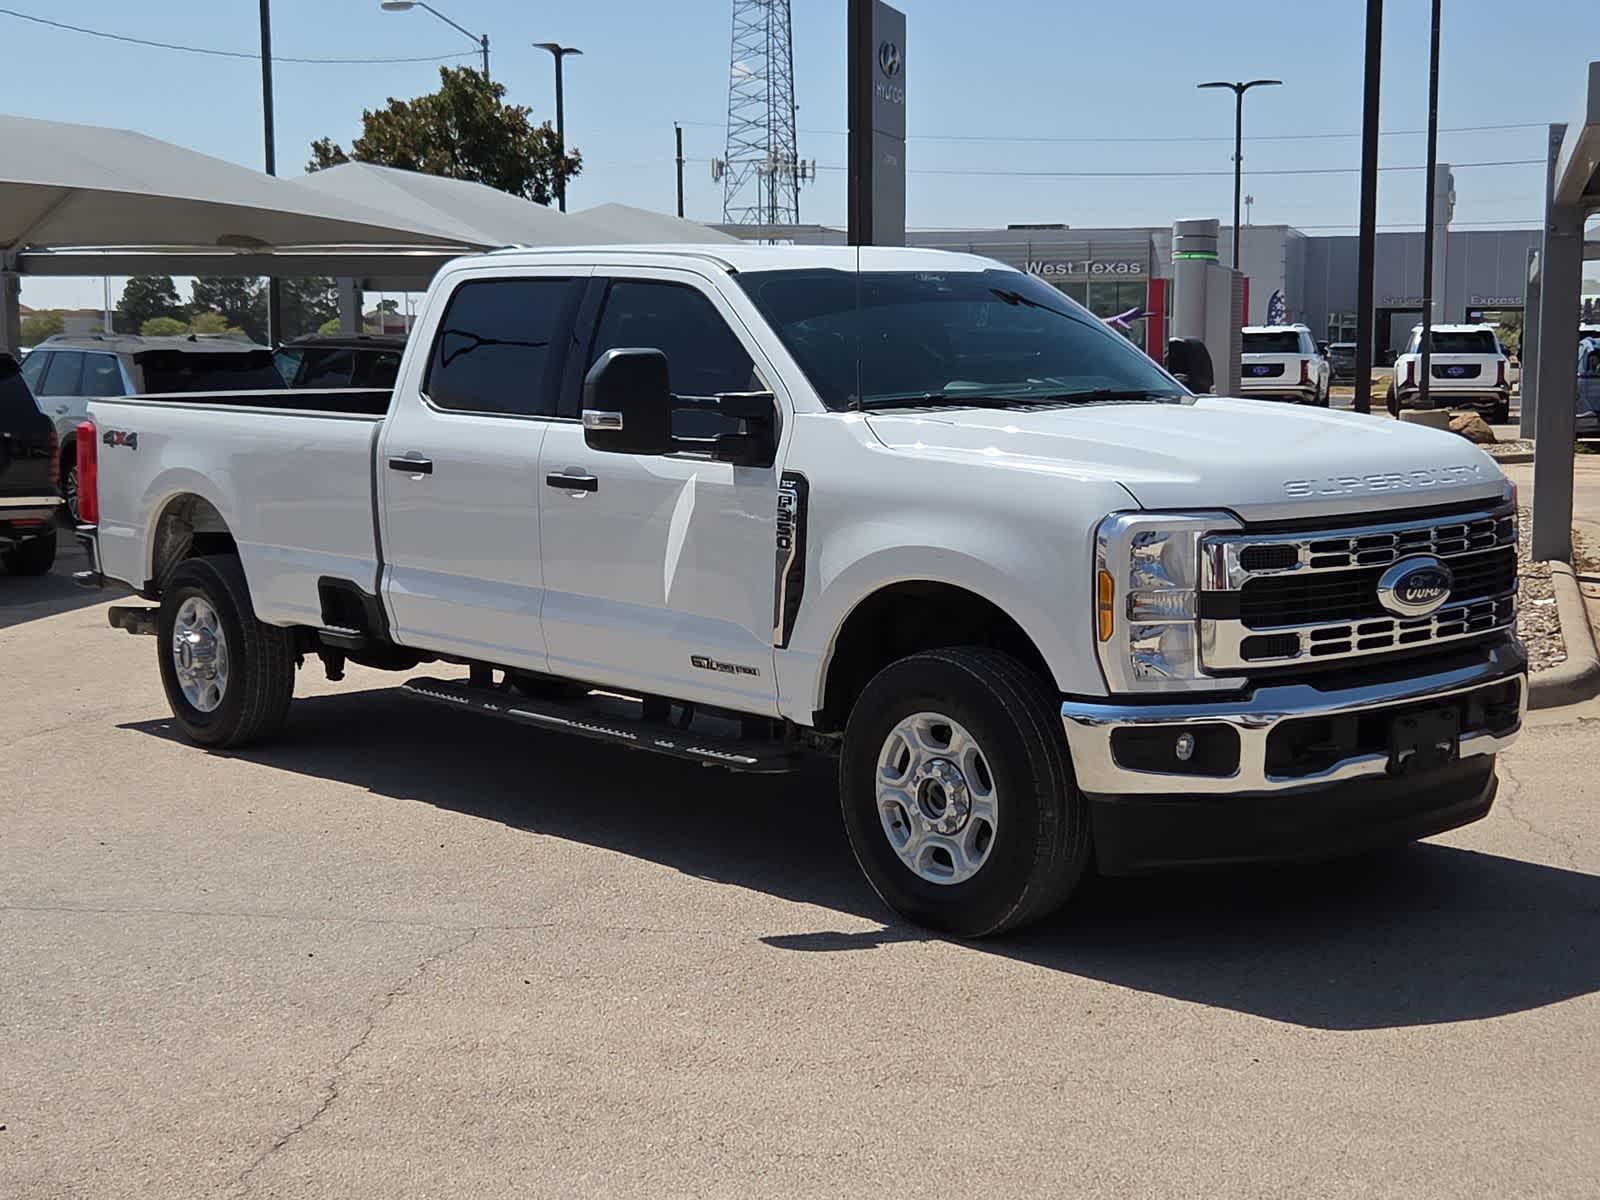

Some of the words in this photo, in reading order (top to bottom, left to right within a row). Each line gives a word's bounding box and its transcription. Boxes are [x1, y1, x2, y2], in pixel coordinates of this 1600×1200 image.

[1025, 261, 1073, 275] West
[1080, 260, 1141, 274] Texas
[1406, 575, 1442, 600] Ford
